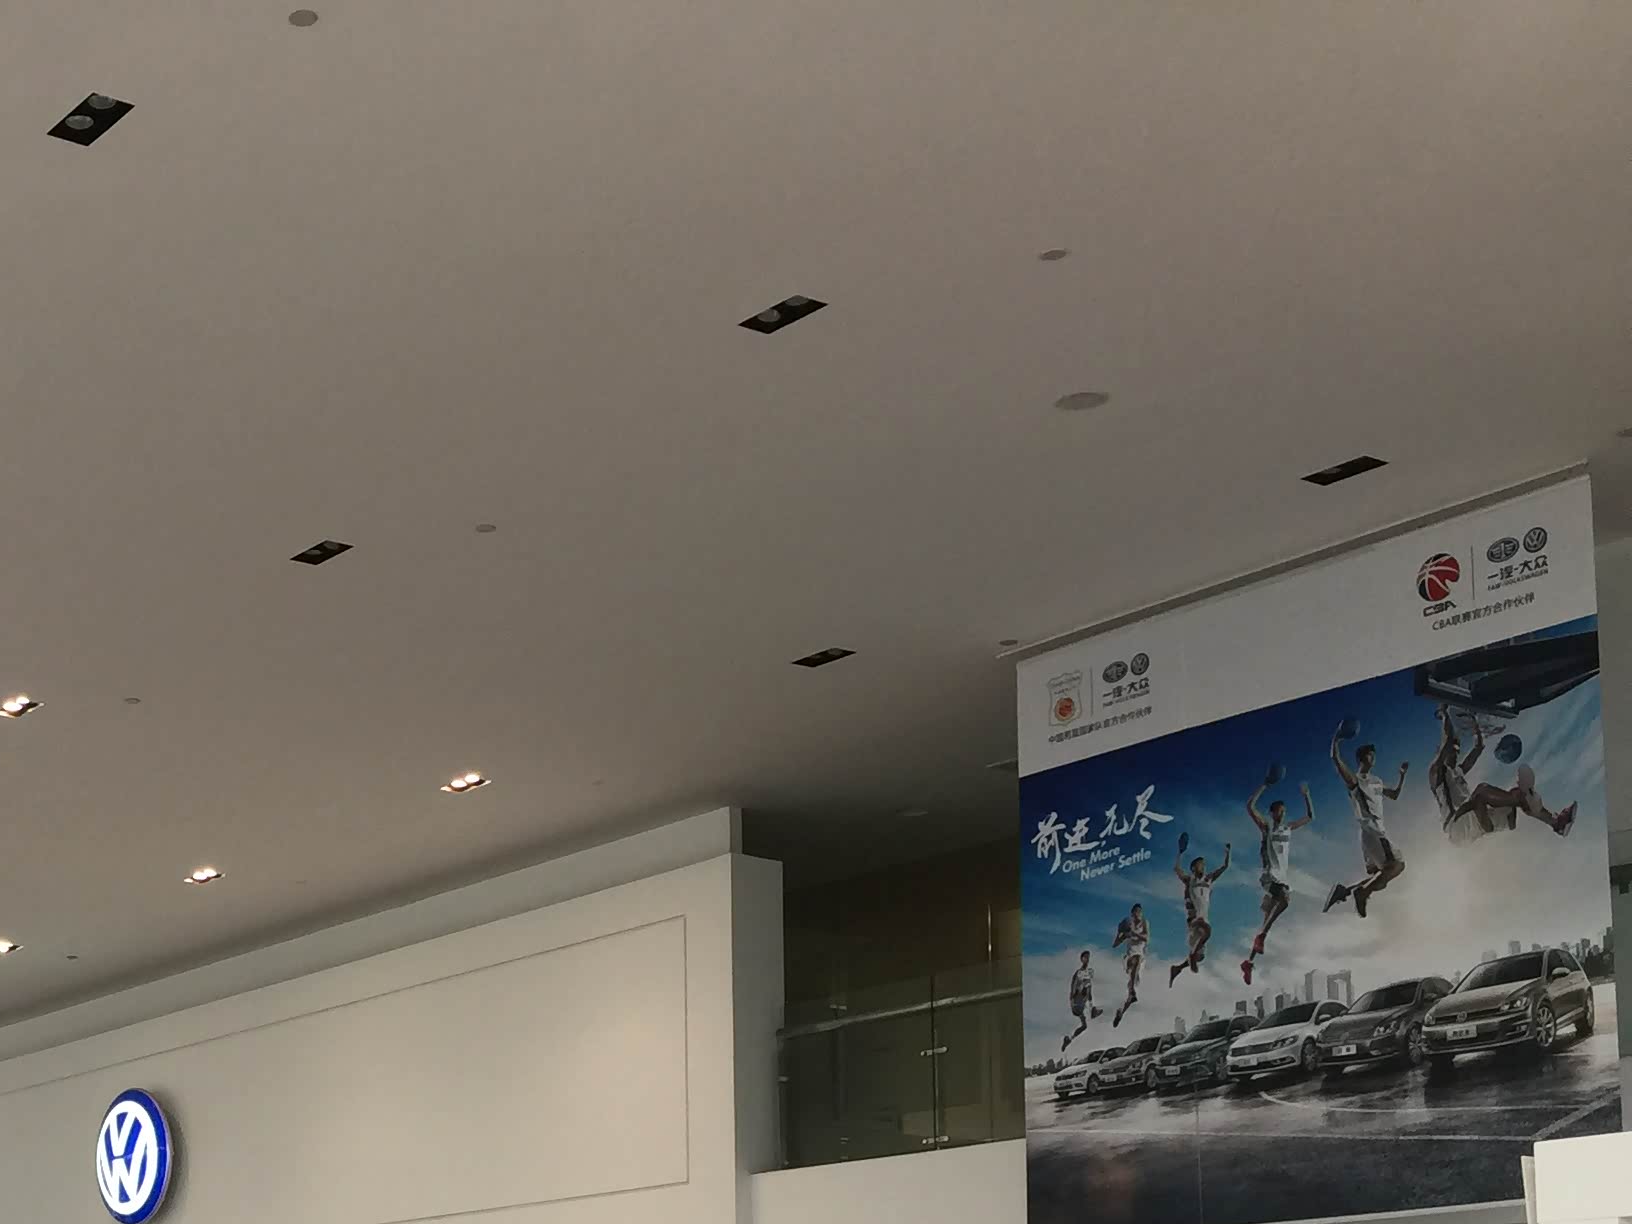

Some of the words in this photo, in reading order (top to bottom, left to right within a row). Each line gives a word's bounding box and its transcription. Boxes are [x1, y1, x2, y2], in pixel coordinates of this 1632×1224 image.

[1062, 858, 1087, 873] One
[1089, 846, 1121, 865] More
[1079, 862, 1115, 881] Never
[1118, 847, 1152, 869] Settle
